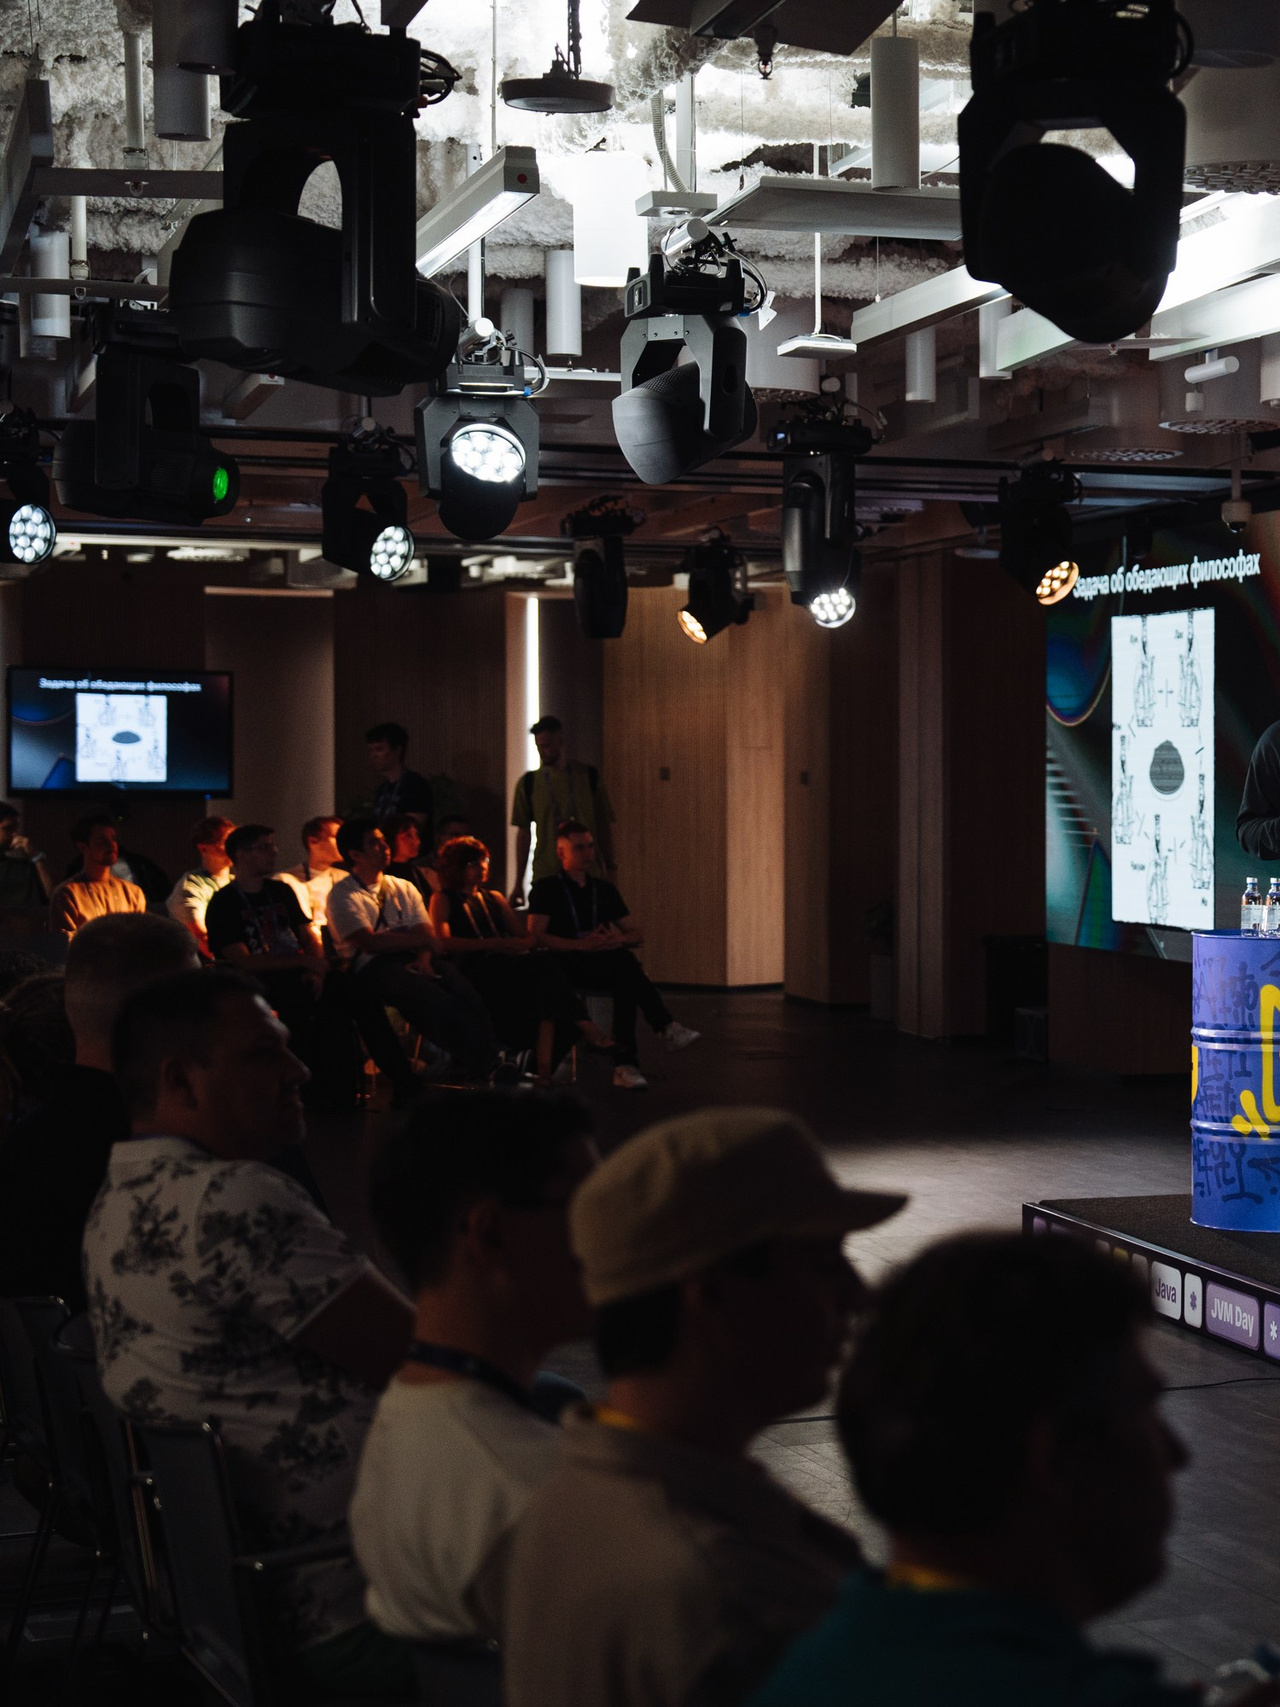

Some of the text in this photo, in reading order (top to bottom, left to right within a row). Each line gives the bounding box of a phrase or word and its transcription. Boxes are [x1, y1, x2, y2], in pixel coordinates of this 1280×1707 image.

[1110, 565, 1125, 594] об
[1125, 563, 1189, 594] обедающих
[1190, 549, 1261, 589] философах
[1155, 1278, 1177, 1304] Java
[1211, 1297, 1254, 1337] JVM Day
